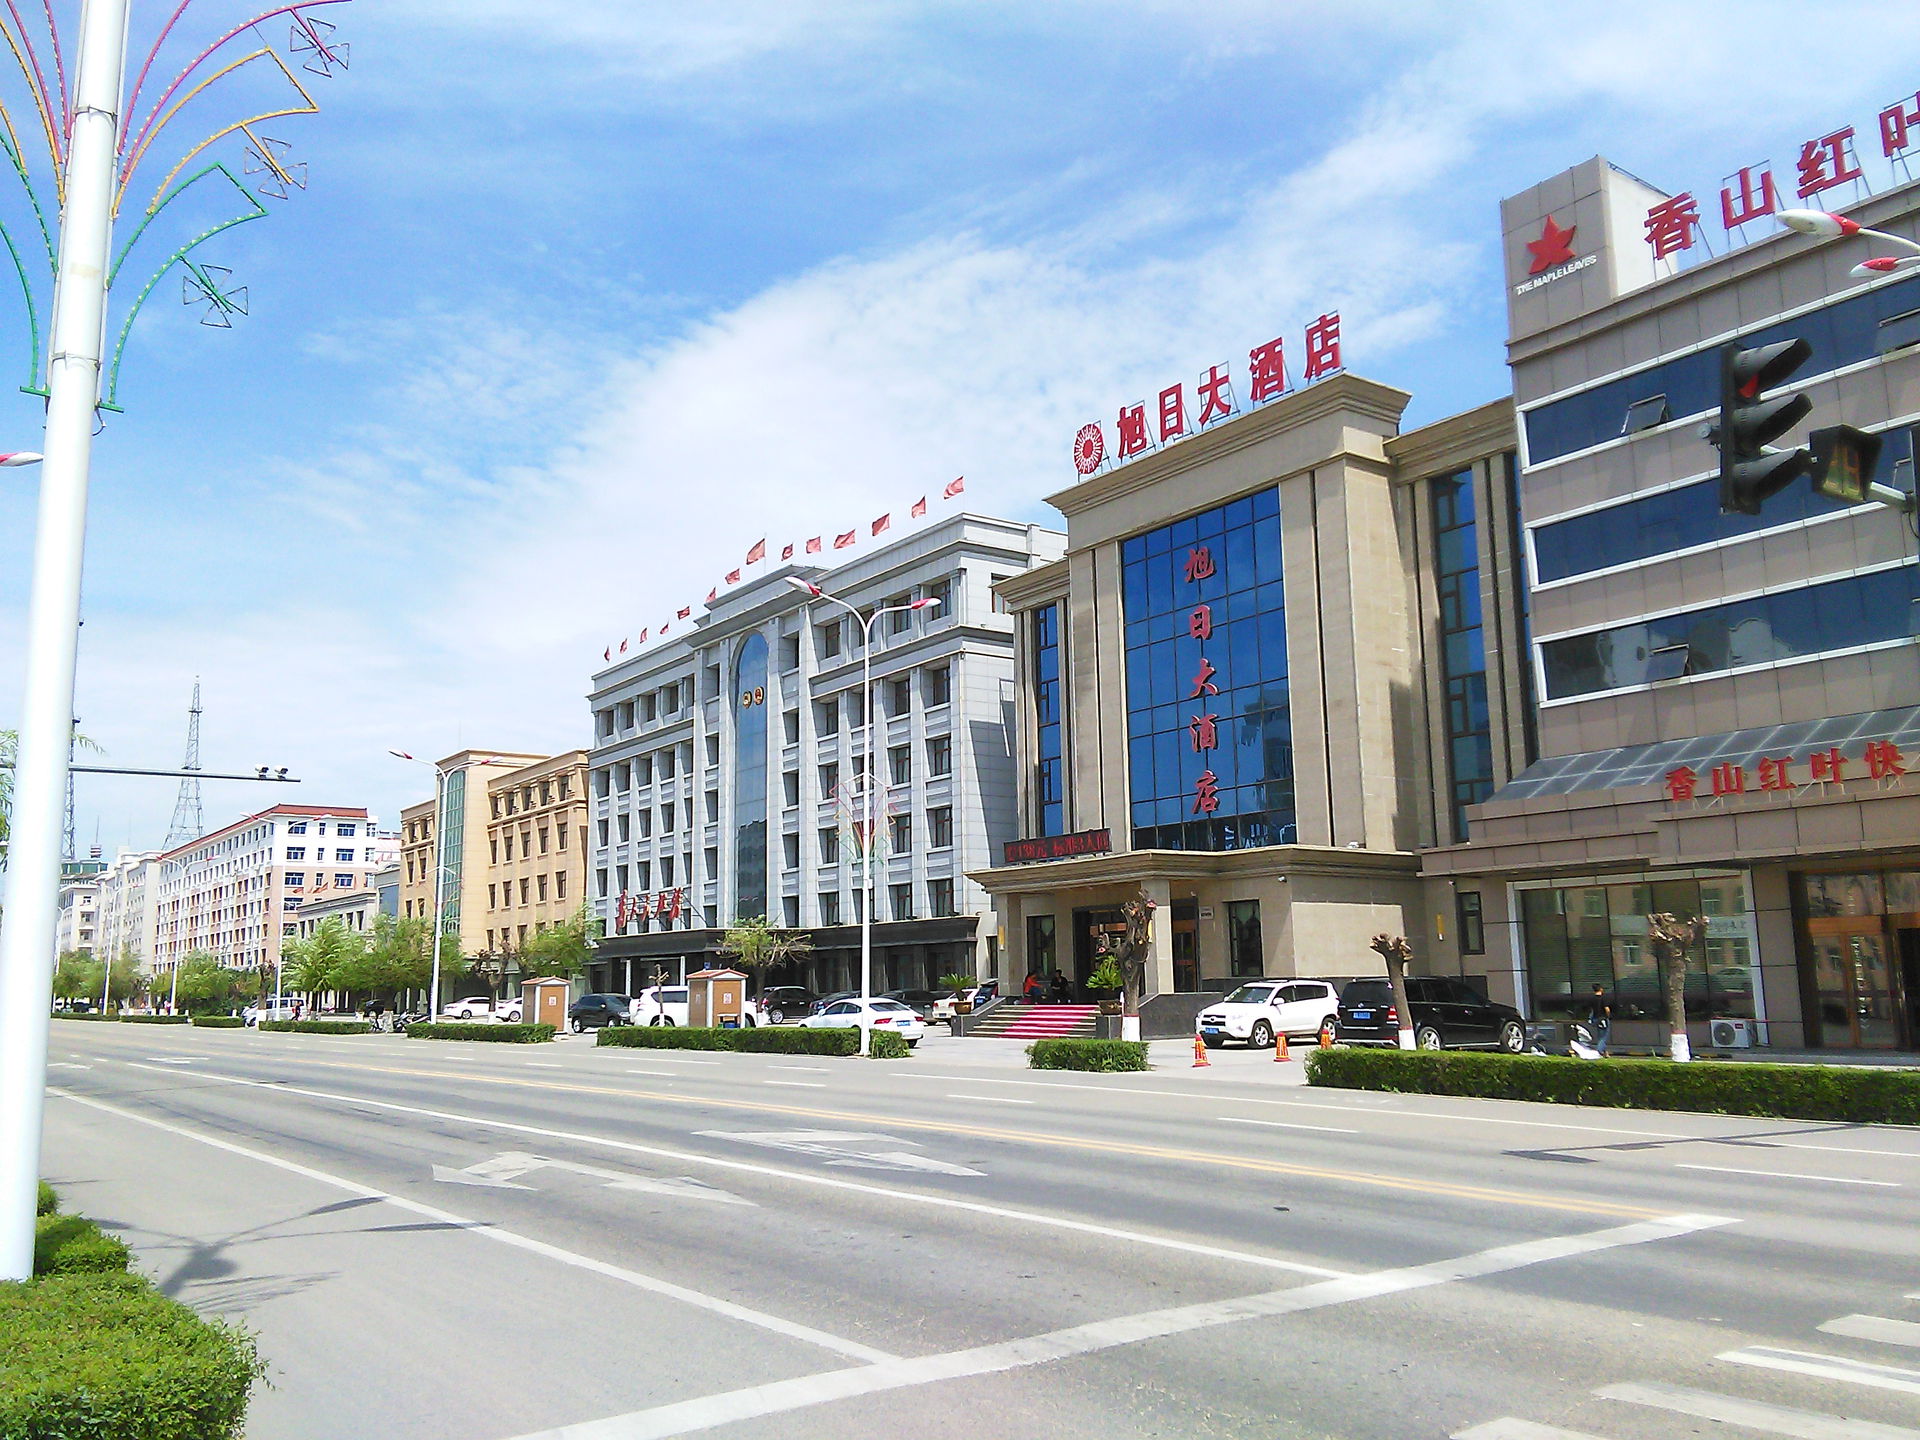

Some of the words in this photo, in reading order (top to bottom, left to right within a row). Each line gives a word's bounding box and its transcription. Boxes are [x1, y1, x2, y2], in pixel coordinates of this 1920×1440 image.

[1117, 314, 1341, 459] 旭日大酒店
[1184, 546, 1219, 814] 旭日大酒店
[1665, 740, 1907, 803] 香山红叶快
